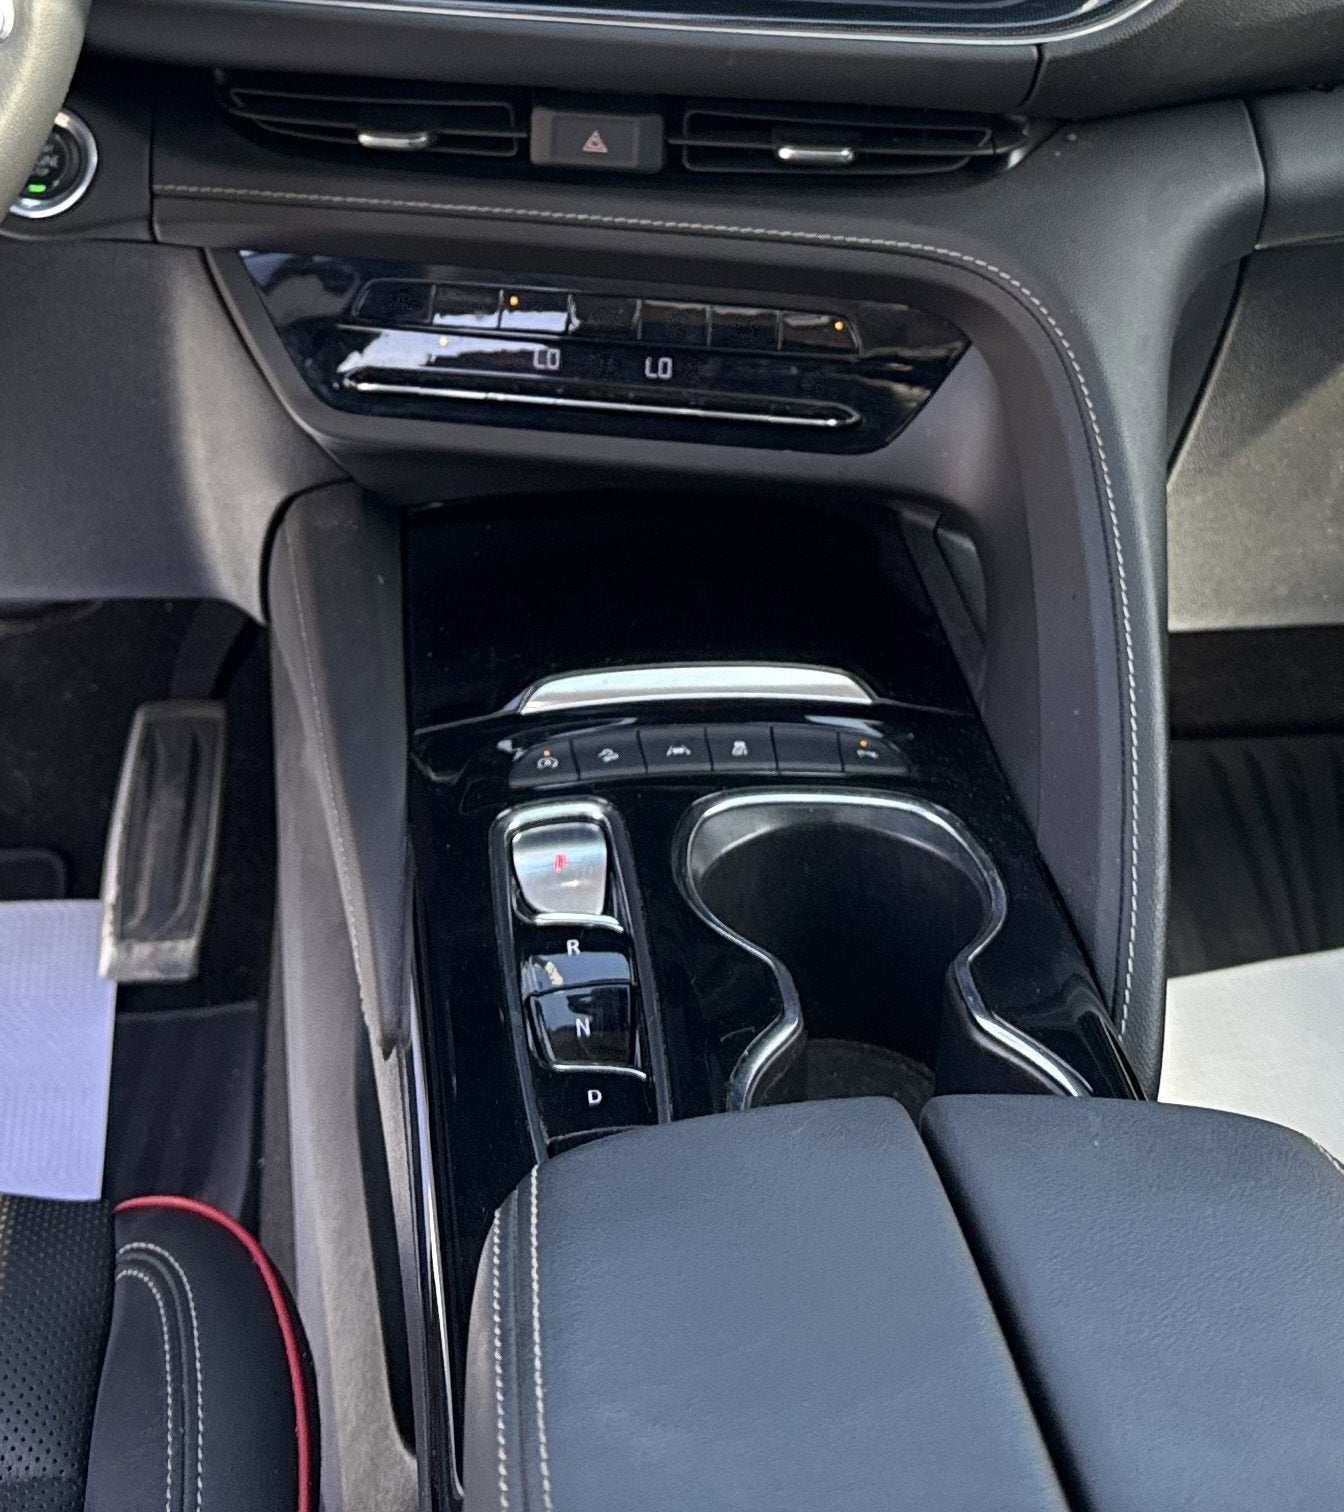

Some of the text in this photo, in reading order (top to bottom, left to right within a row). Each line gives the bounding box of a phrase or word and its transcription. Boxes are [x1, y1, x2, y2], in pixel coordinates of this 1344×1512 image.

[645, 357, 673, 381] LO
[567, 939, 581, 956] R
[576, 1017, 591, 1037] N
[587, 1089, 602, 1106] D
